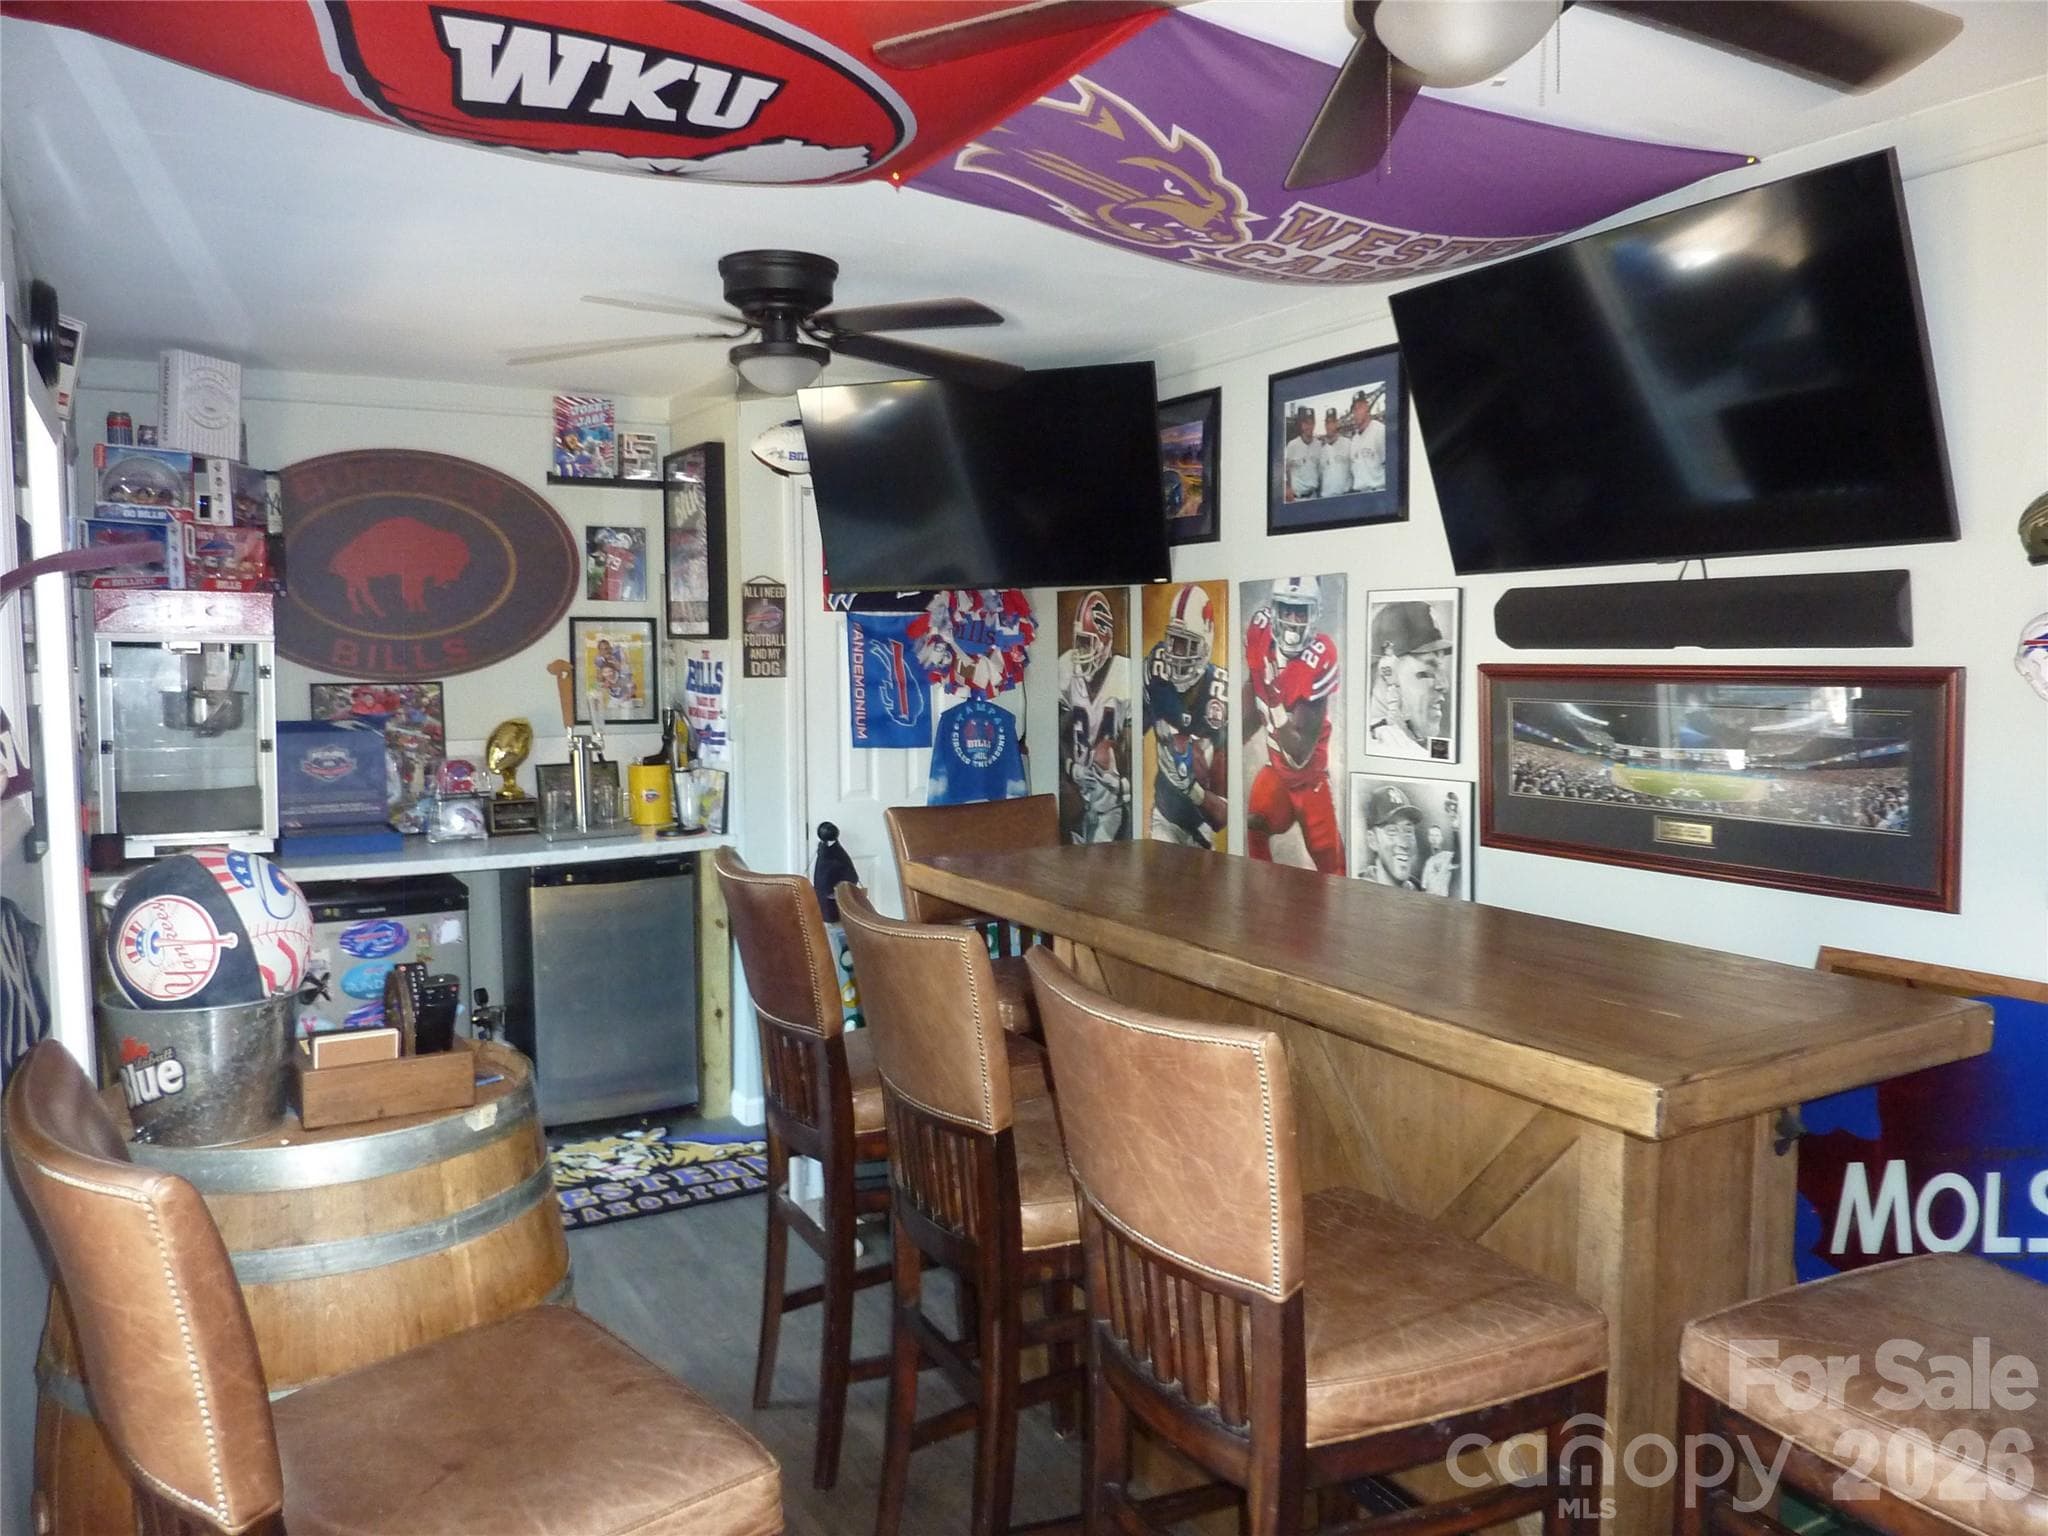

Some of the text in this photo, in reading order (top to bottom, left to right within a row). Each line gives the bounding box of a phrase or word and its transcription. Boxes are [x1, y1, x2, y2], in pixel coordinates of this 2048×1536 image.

[438, 14, 780, 130] WKU
[789, 451, 808, 461] BIL
[744, 586, 759, 598] ALL
[764, 587, 785, 598] NEED
[744, 633, 785, 647] FOOTBALL
[330, 638, 469, 672] BILLS
[751, 648, 780, 660] AND MY
[751, 661, 780, 676] DOG
[558, 1155, 768, 1211] ESTERN
